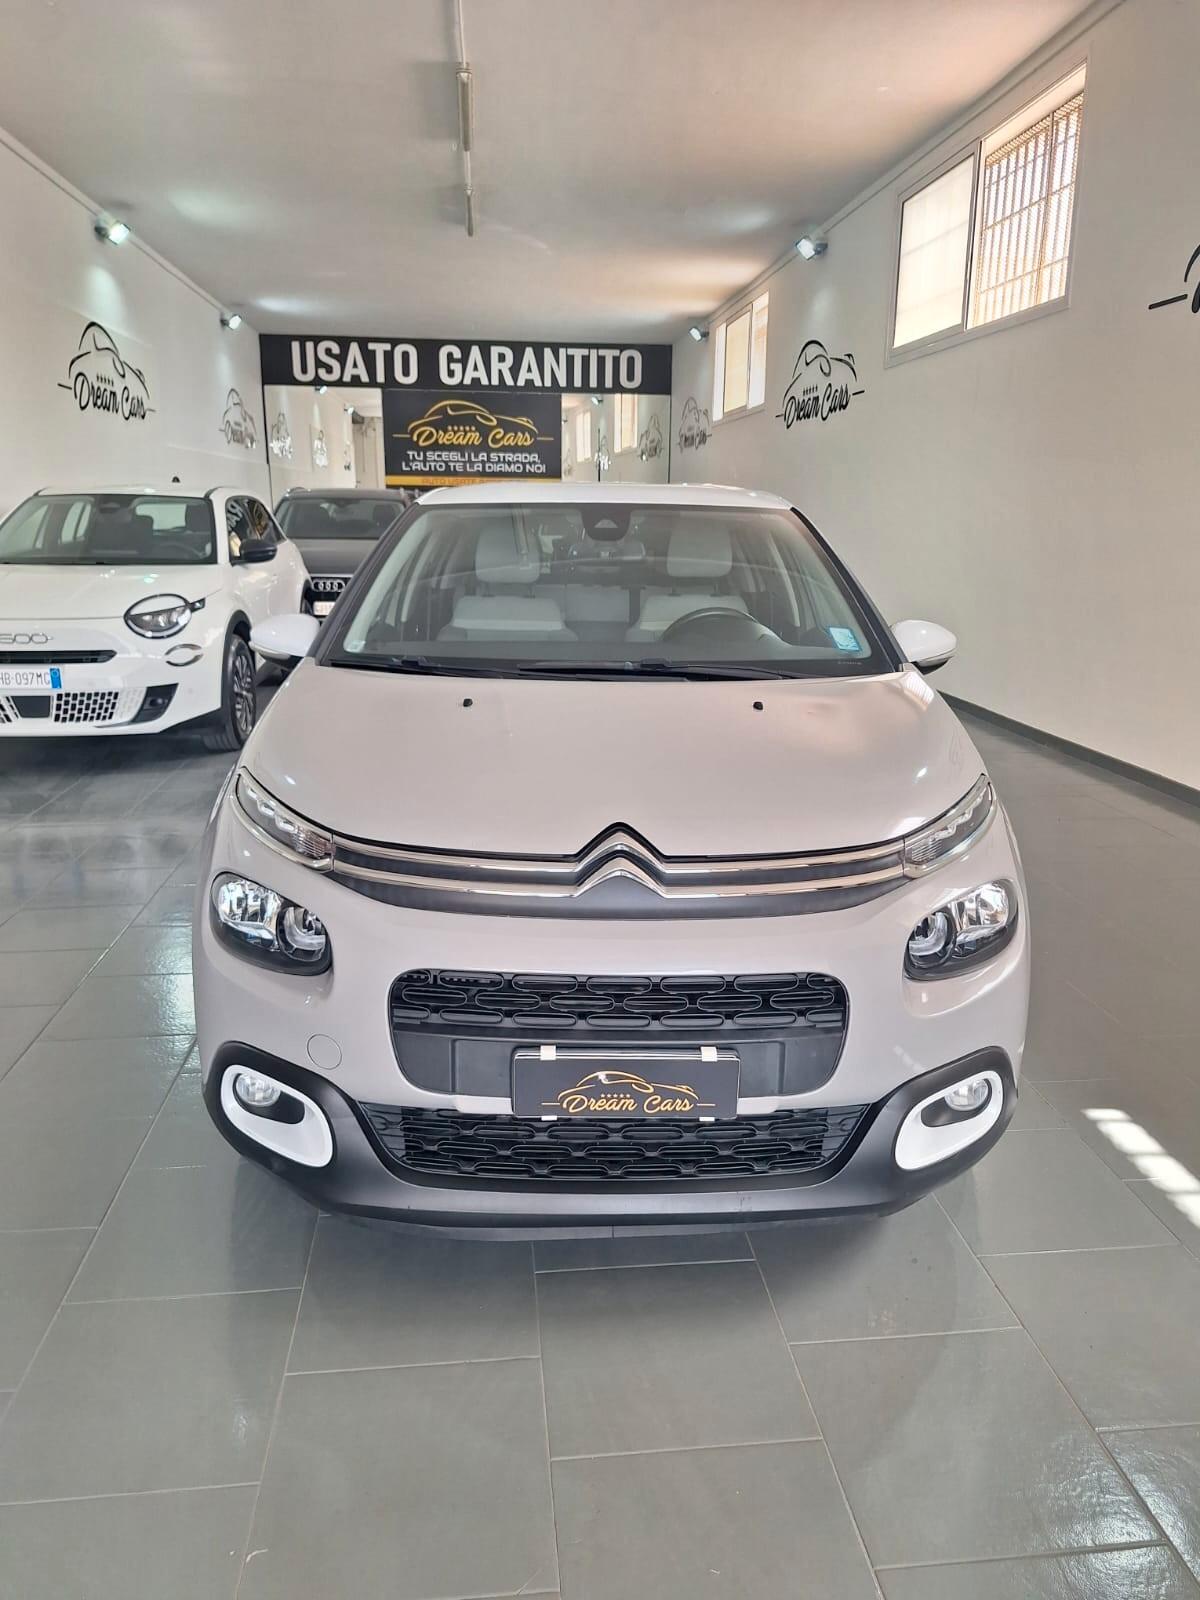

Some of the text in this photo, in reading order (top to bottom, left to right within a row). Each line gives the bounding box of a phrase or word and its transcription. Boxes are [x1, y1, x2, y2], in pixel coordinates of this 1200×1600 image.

[291, 340, 643, 388] USATO GARANTITO
[74, 372, 146, 420] Dream Cars
[783, 382, 850, 430] Dream Cars
[412, 426, 534, 448] Dream Cars
[402, 461, 546, 473] L'AUTO TE LA DIAMO NOI
[407, 451, 541, 463] TU SCEGLI LA STRADA,
[562, 1095, 694, 1114] Dream Cars
